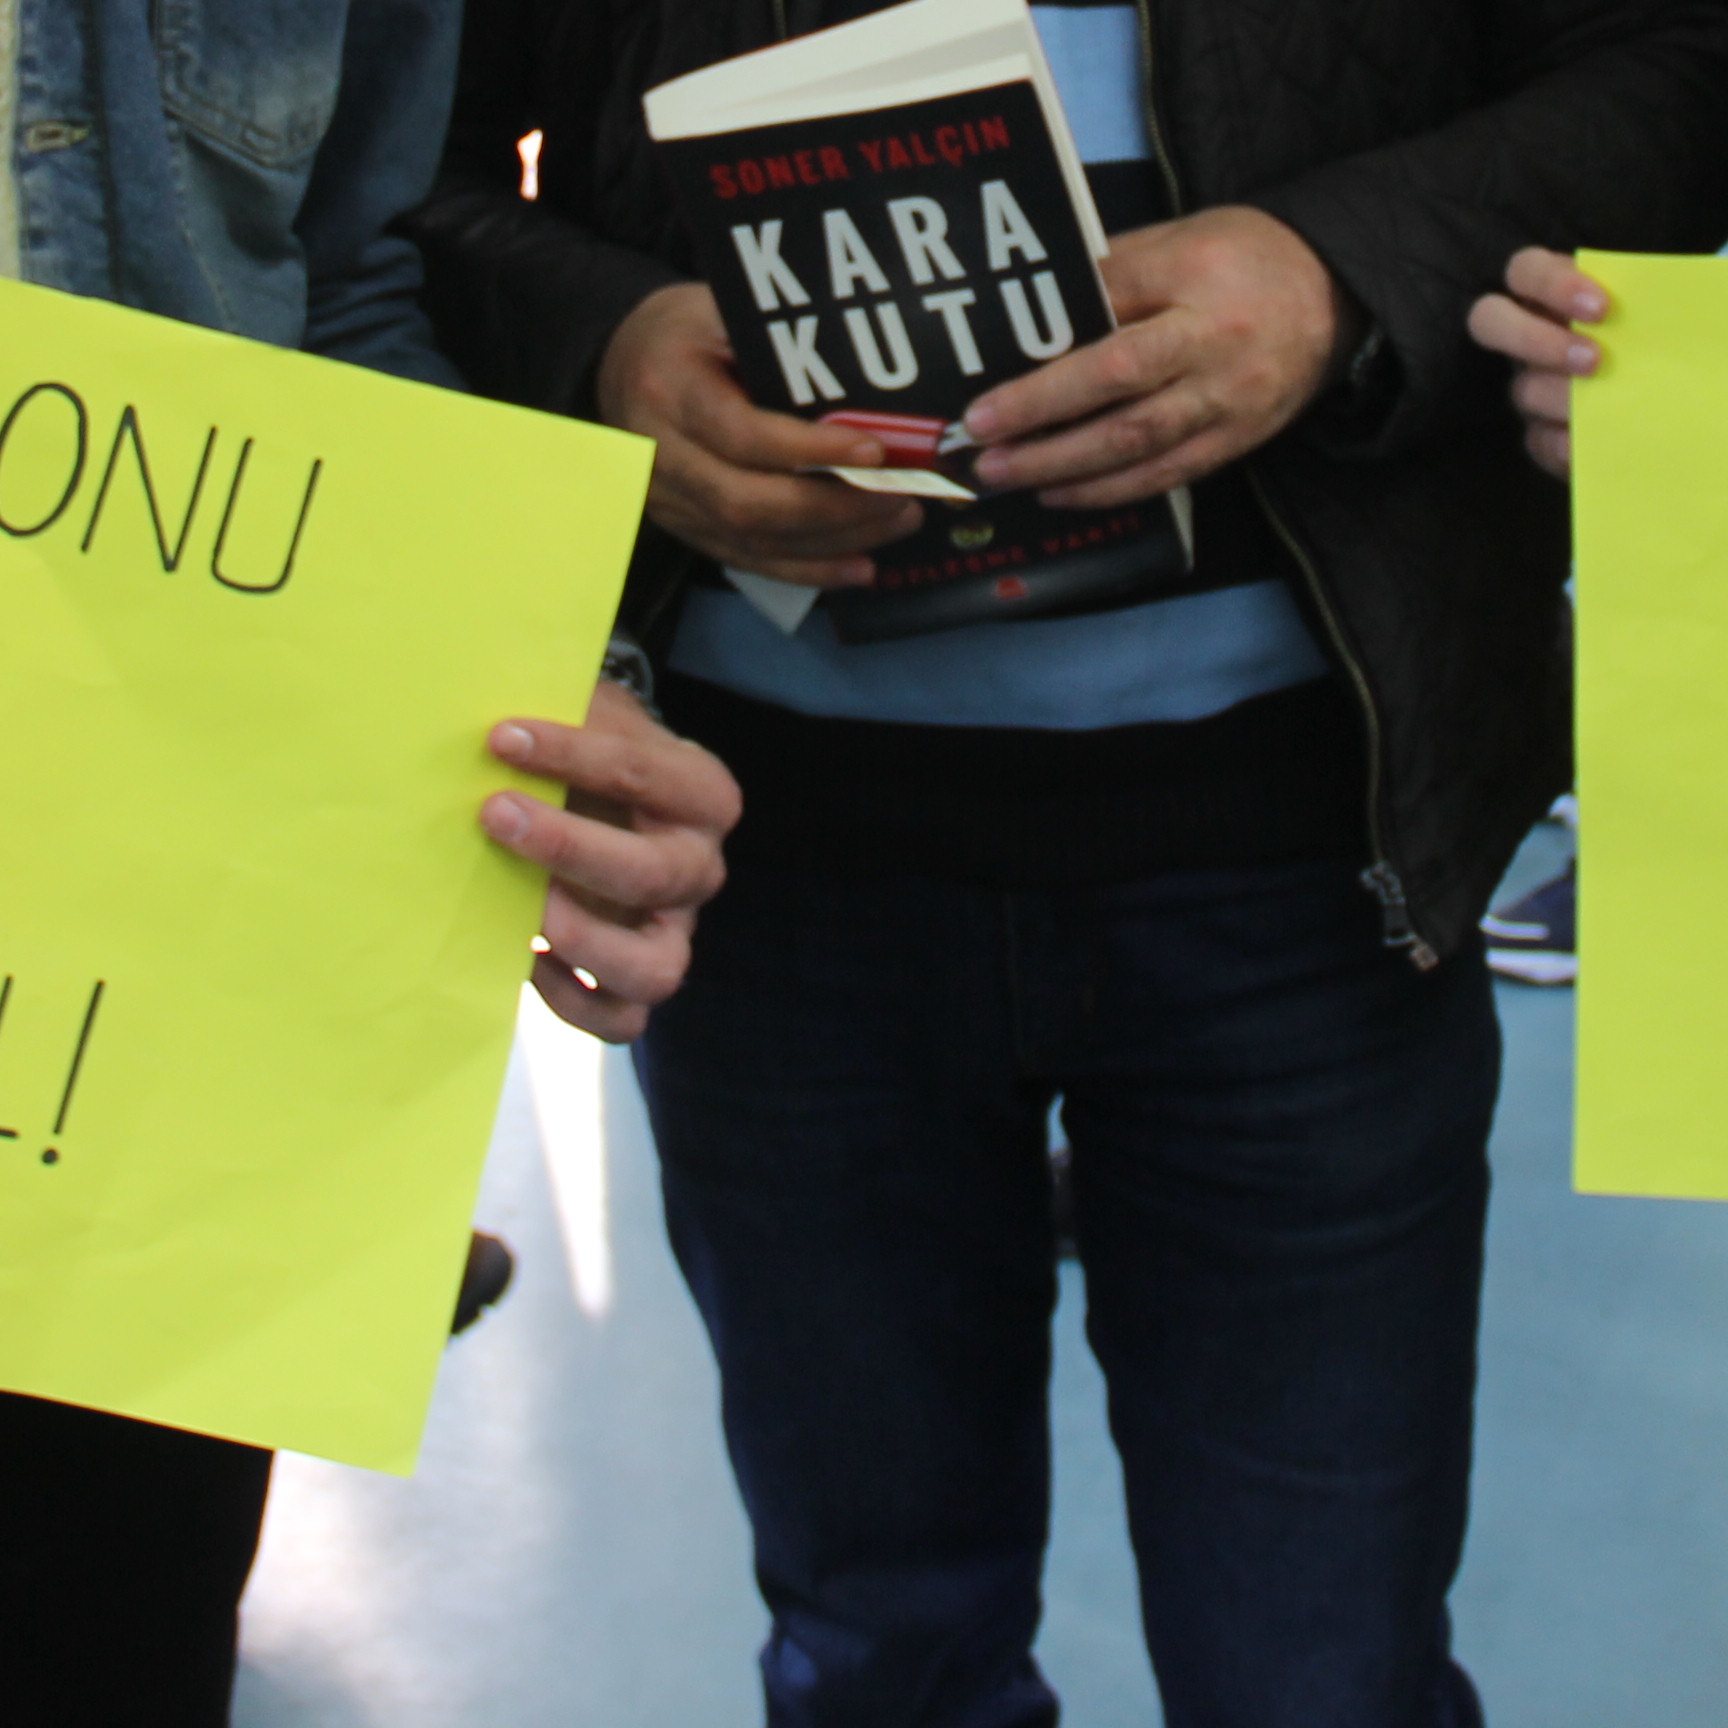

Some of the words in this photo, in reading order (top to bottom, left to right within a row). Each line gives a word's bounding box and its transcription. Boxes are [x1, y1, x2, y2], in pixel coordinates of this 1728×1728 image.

[709, 146, 851, 200] SONER
[858, 115, 1011, 172] YALÇIN
[730, 179, 1049, 313] KARA
[766, 270, 1074, 406] KUTU
